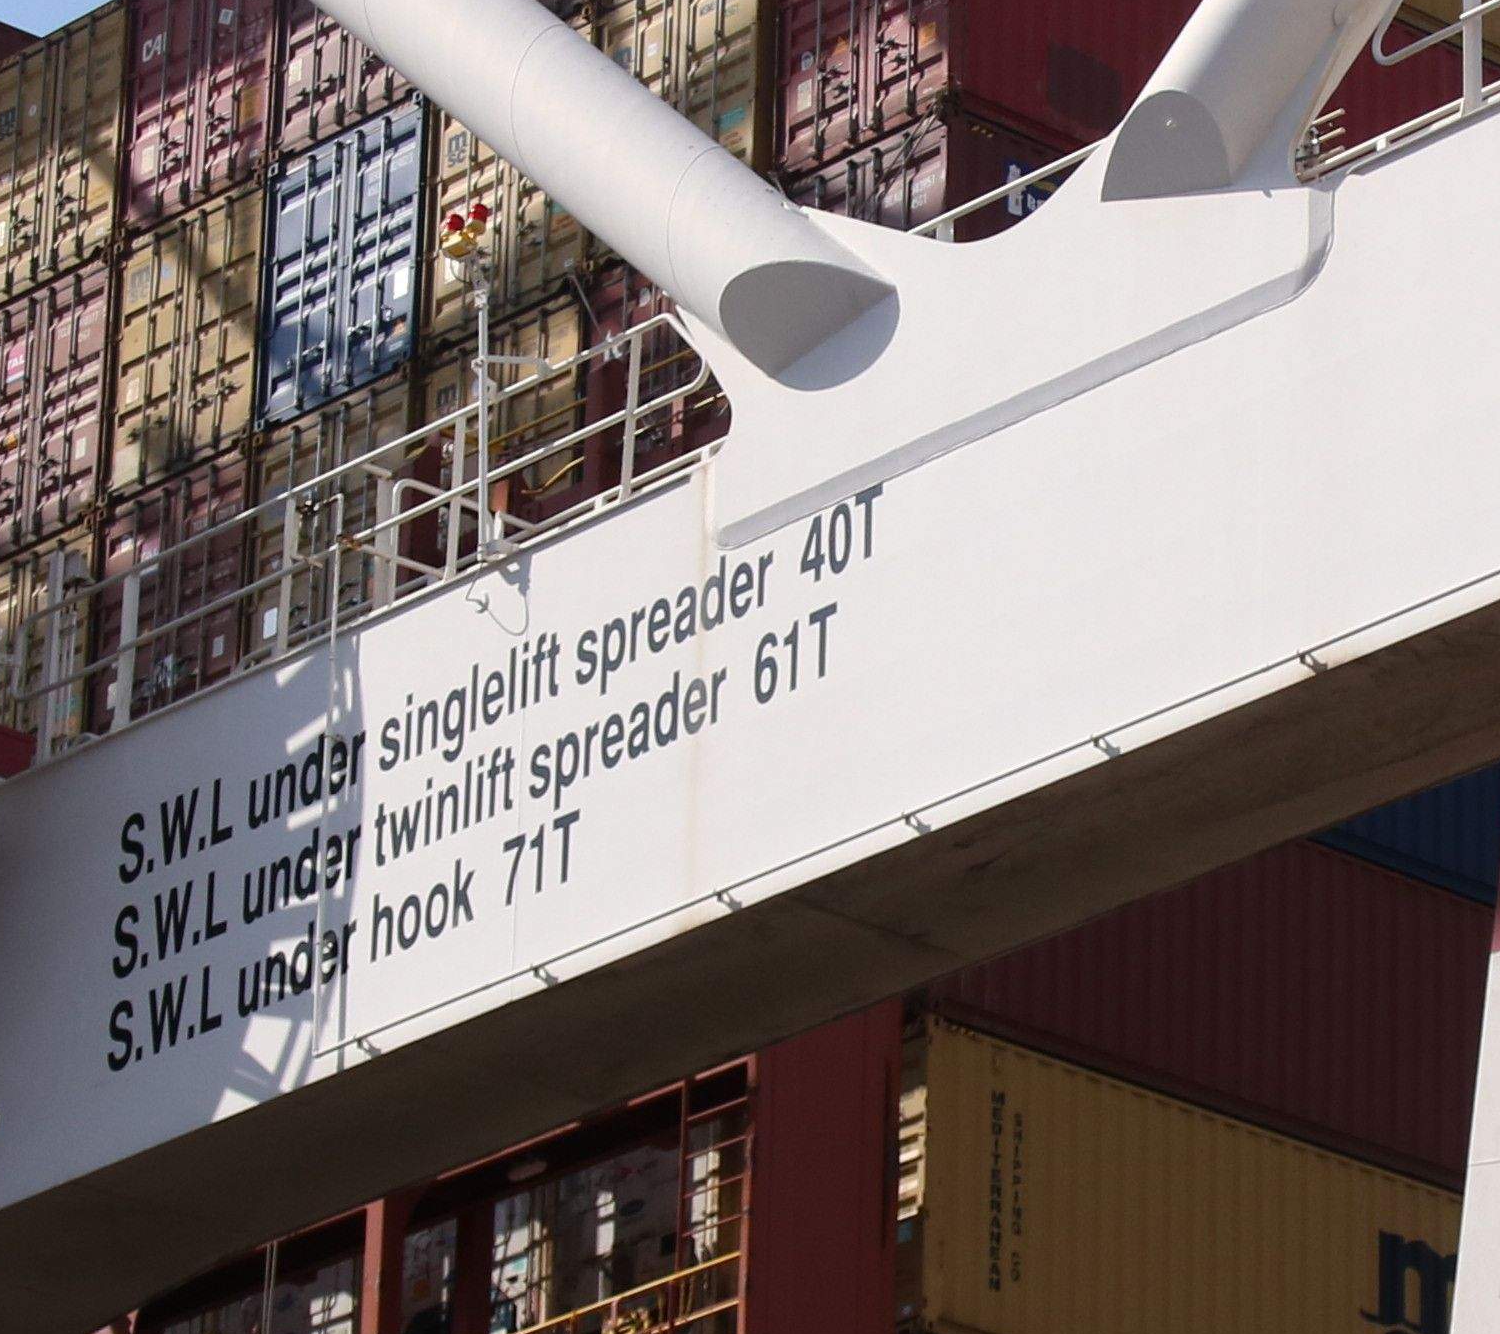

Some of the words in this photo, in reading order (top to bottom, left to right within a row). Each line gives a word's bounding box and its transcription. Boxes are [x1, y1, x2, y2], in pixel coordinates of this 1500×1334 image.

[113, 884, 228, 980] S.W.L
[243, 827, 360, 925] under
[375, 749, 516, 868] twinlift
[529, 664, 727, 805] spreader
[753, 603, 837, 704] 61T
[119, 792, 232, 885] S.W.L
[248, 733, 365, 832] under
[379, 650, 560, 774] singlelift
[576, 552, 774, 689] spreader
[799, 486, 885, 584] 40T
[108, 974, 223, 1073] S.W.L
[238, 916, 358, 1019] under
[371, 867, 475, 964] hook
[501, 812, 580, 906] 71T
[989, 1089, 1007, 1293] MEDITERRANEAN
[1011, 1113, 1025, 1238] SHIPPING
